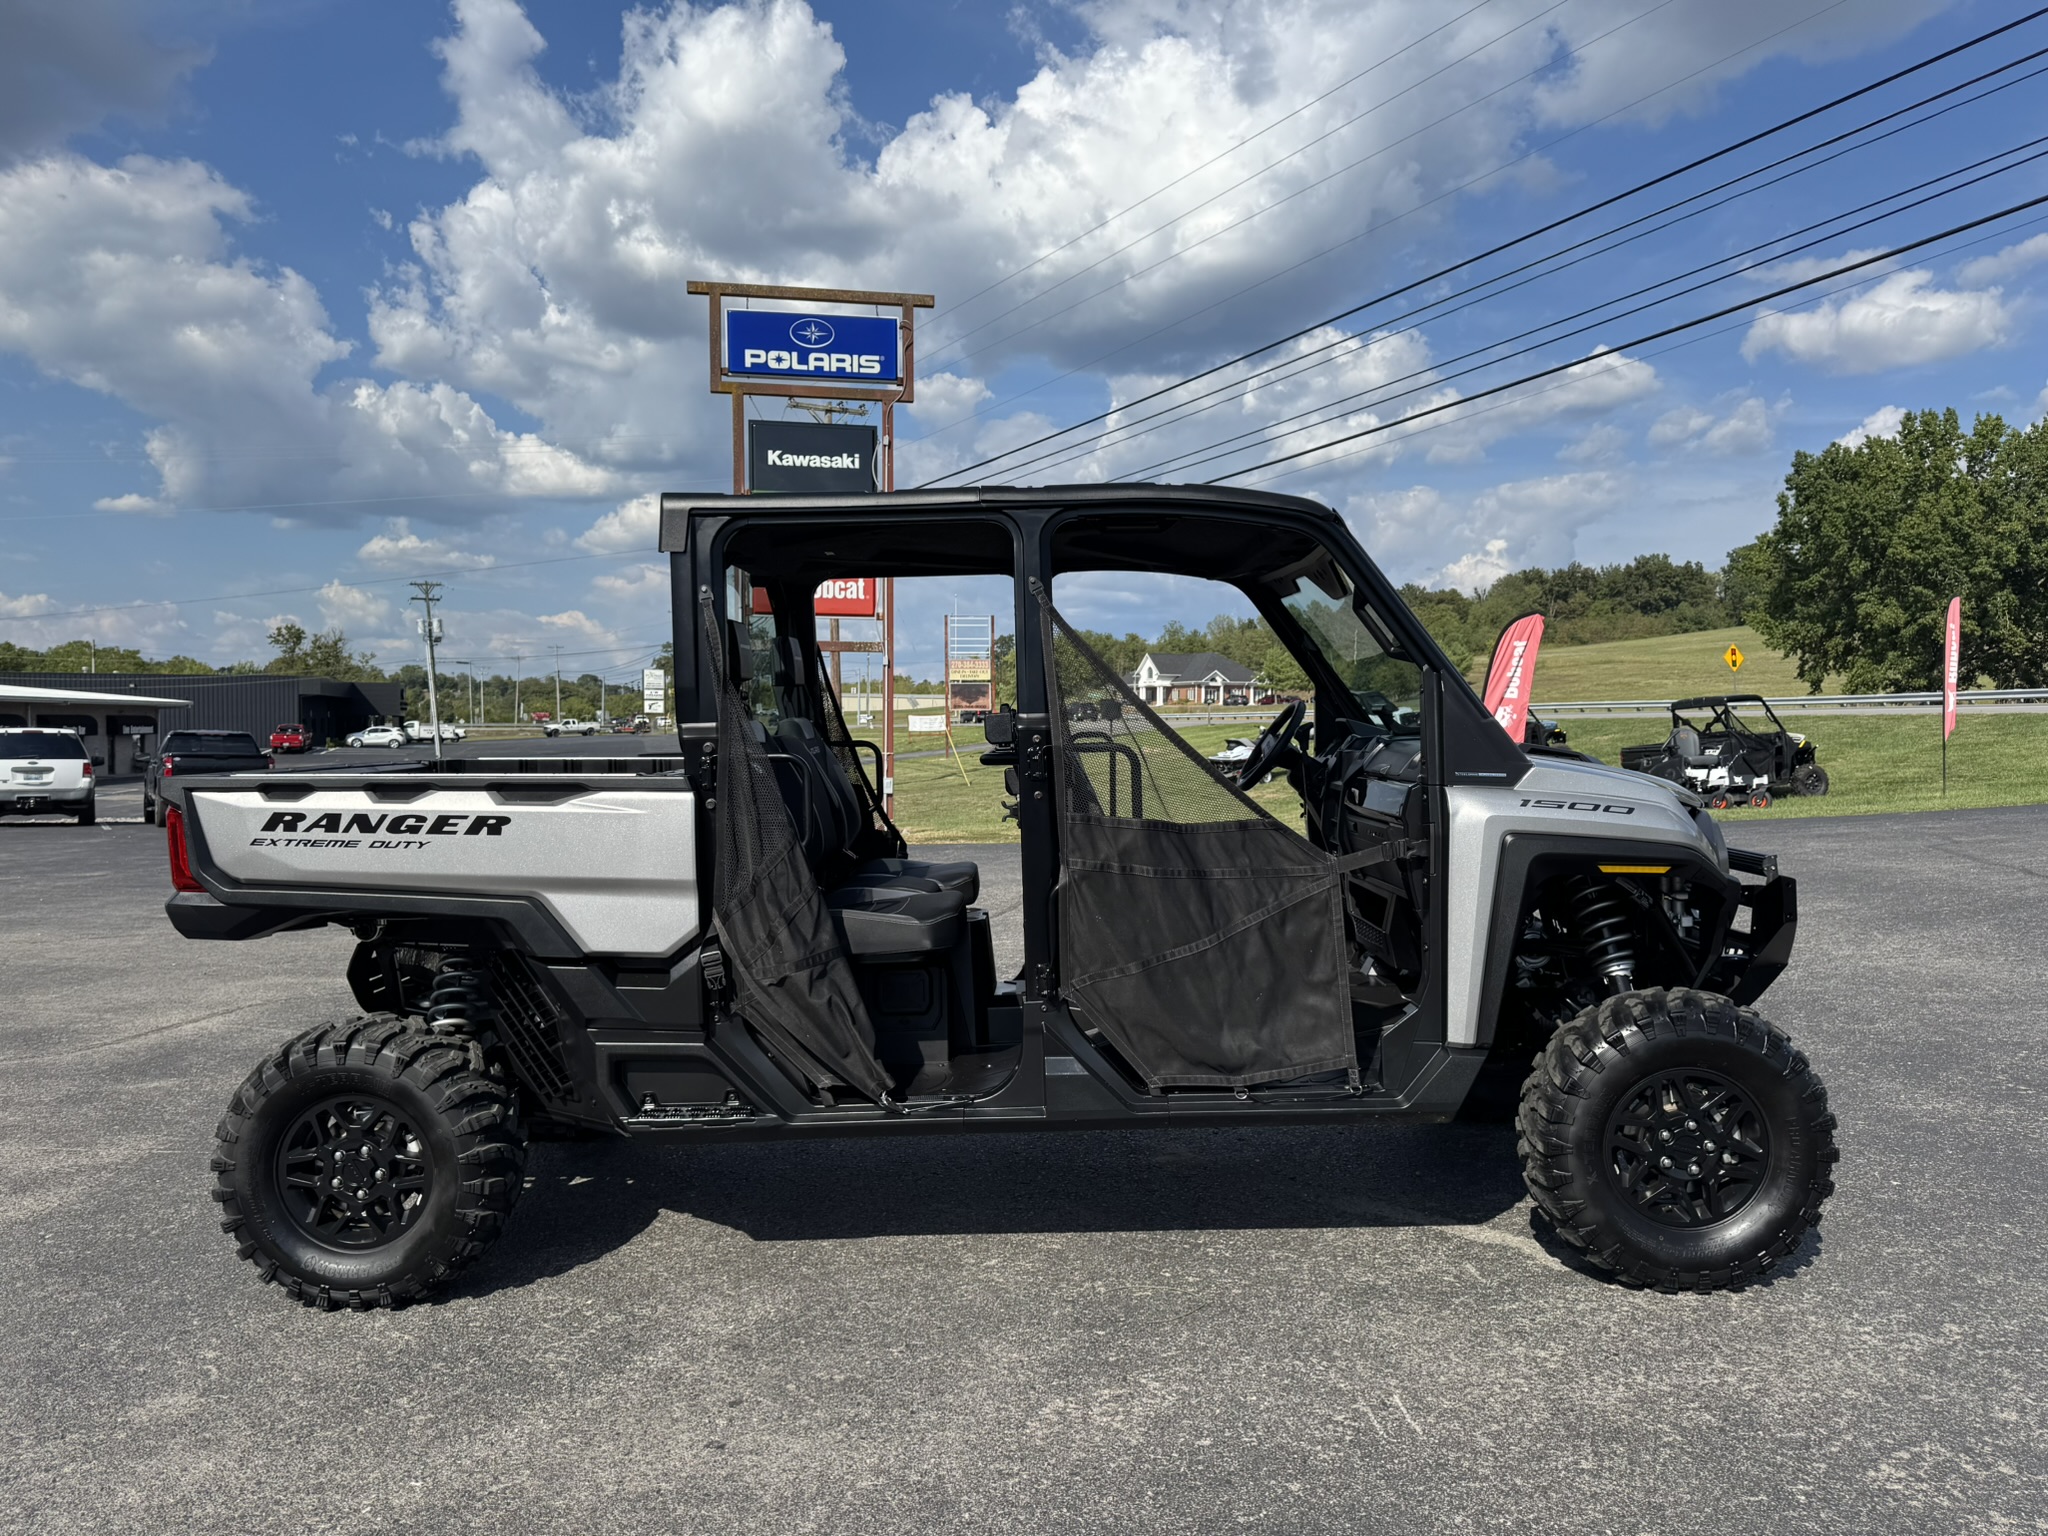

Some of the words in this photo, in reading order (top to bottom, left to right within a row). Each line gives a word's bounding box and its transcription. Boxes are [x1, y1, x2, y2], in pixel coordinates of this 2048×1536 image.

[744, 348, 882, 374] POLARIS
[767, 449, 860, 470] Kawasaki
[814, 578, 866, 600] bcat
[1519, 798, 1636, 815] 1500
[260, 811, 512, 836] RANGER
[249, 838, 362, 848] EXTREME
[367, 840, 432, 850] DUTY
